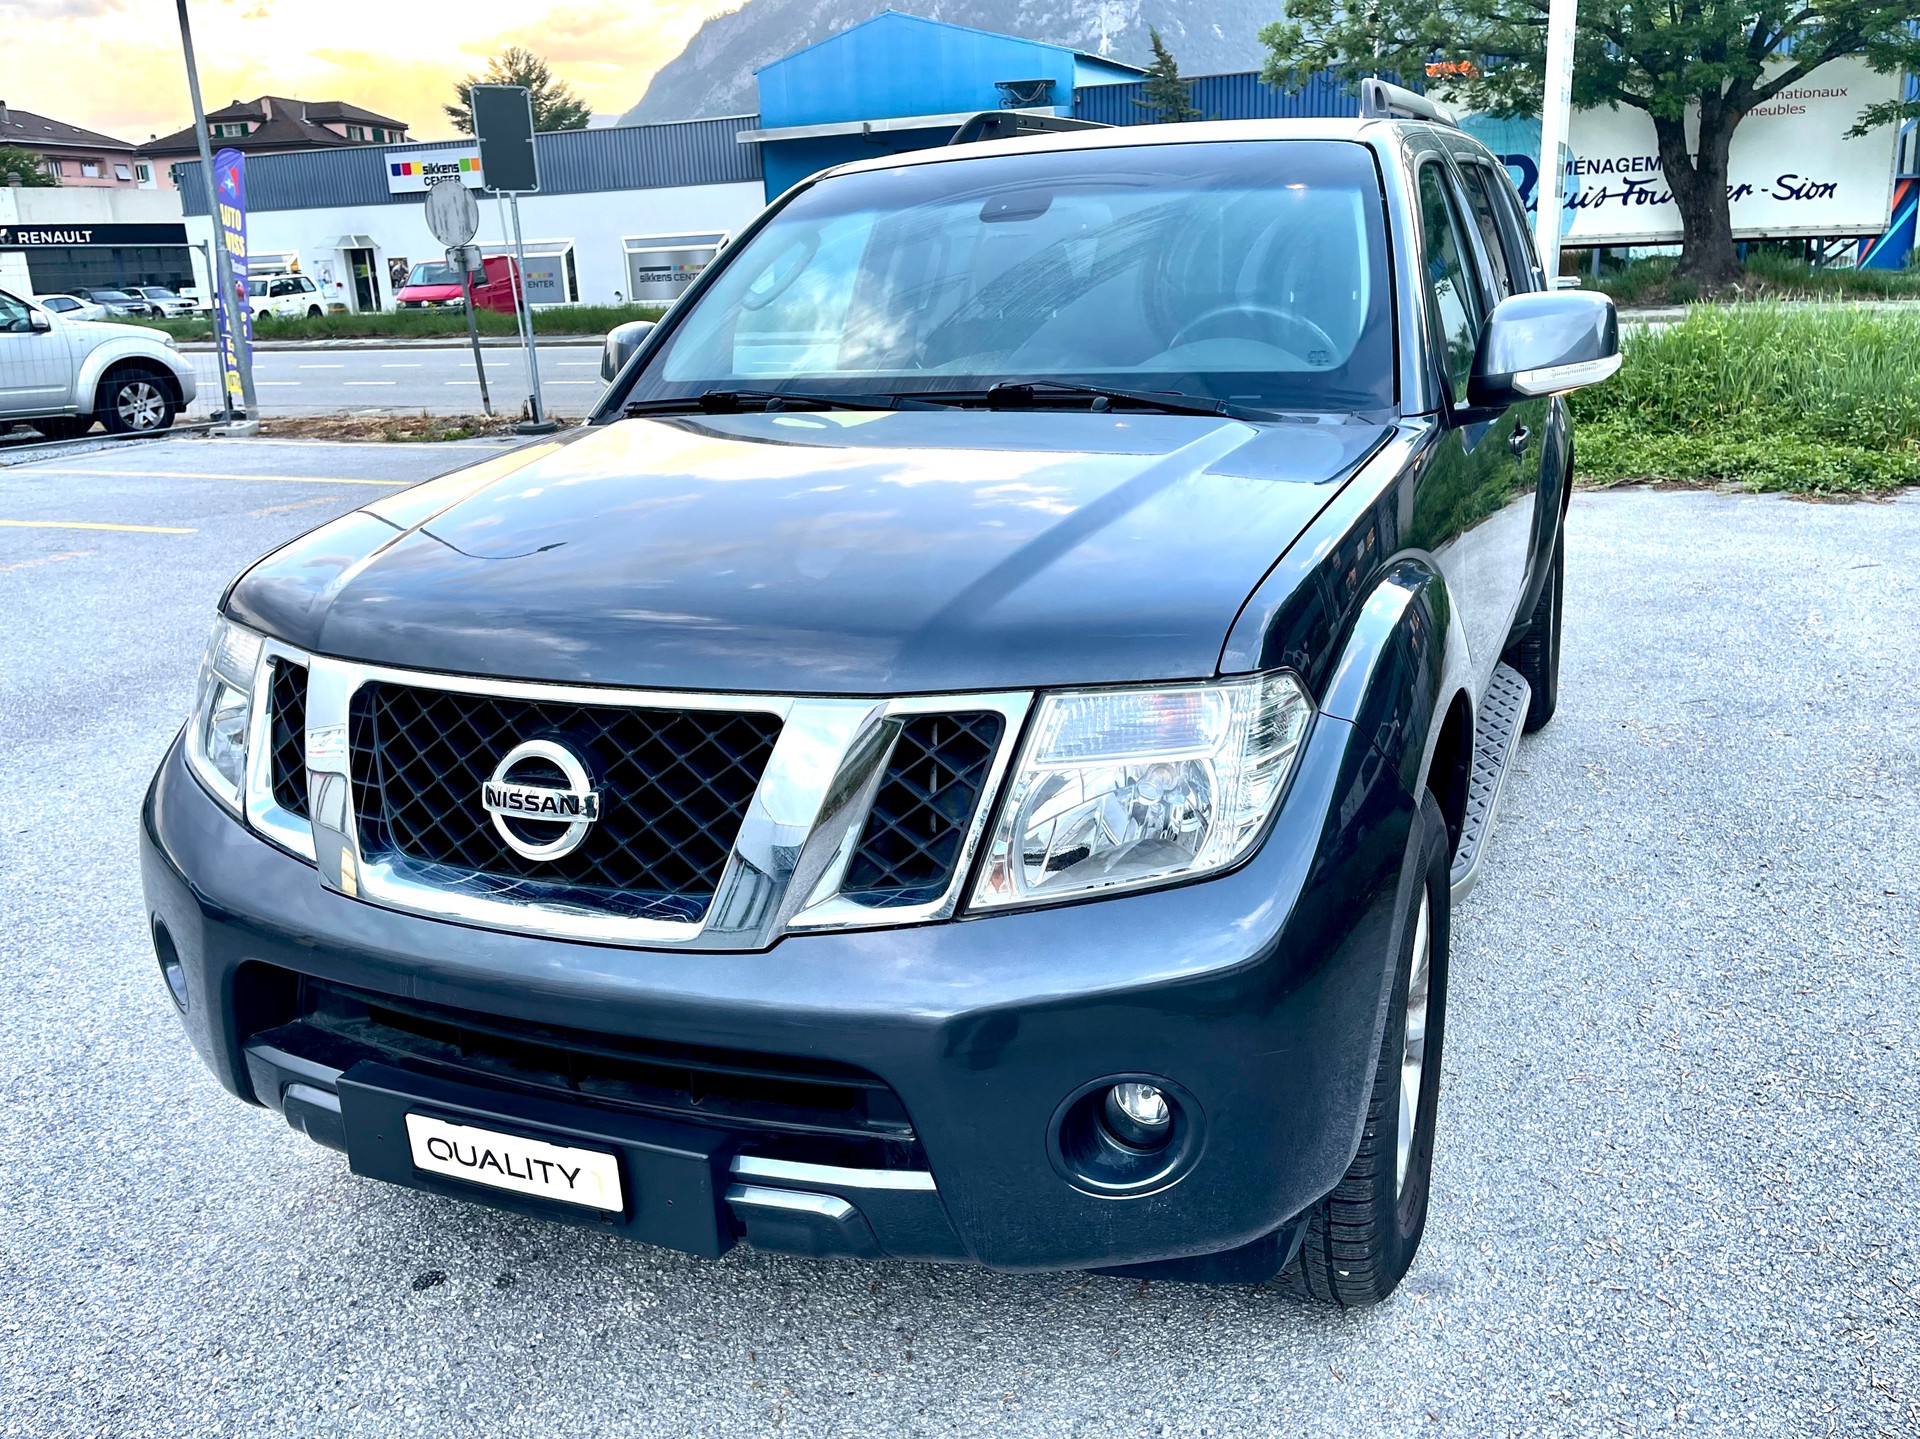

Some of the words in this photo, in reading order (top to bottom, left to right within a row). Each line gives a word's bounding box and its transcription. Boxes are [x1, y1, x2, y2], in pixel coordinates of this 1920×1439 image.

[1771, 87, 1848, 100] nationaux
[422, 163, 459, 175] sikkens
[1772, 174, 1837, 201] Sion
[17, 230, 93, 244] RENAULT
[640, 271, 672, 283] sikkens
[674, 272, 699, 282] CENT
[527, 280, 555, 289] ENTER
[487, 788, 580, 815] NISSAN
[427, 1137, 581, 1189] QUALITY
